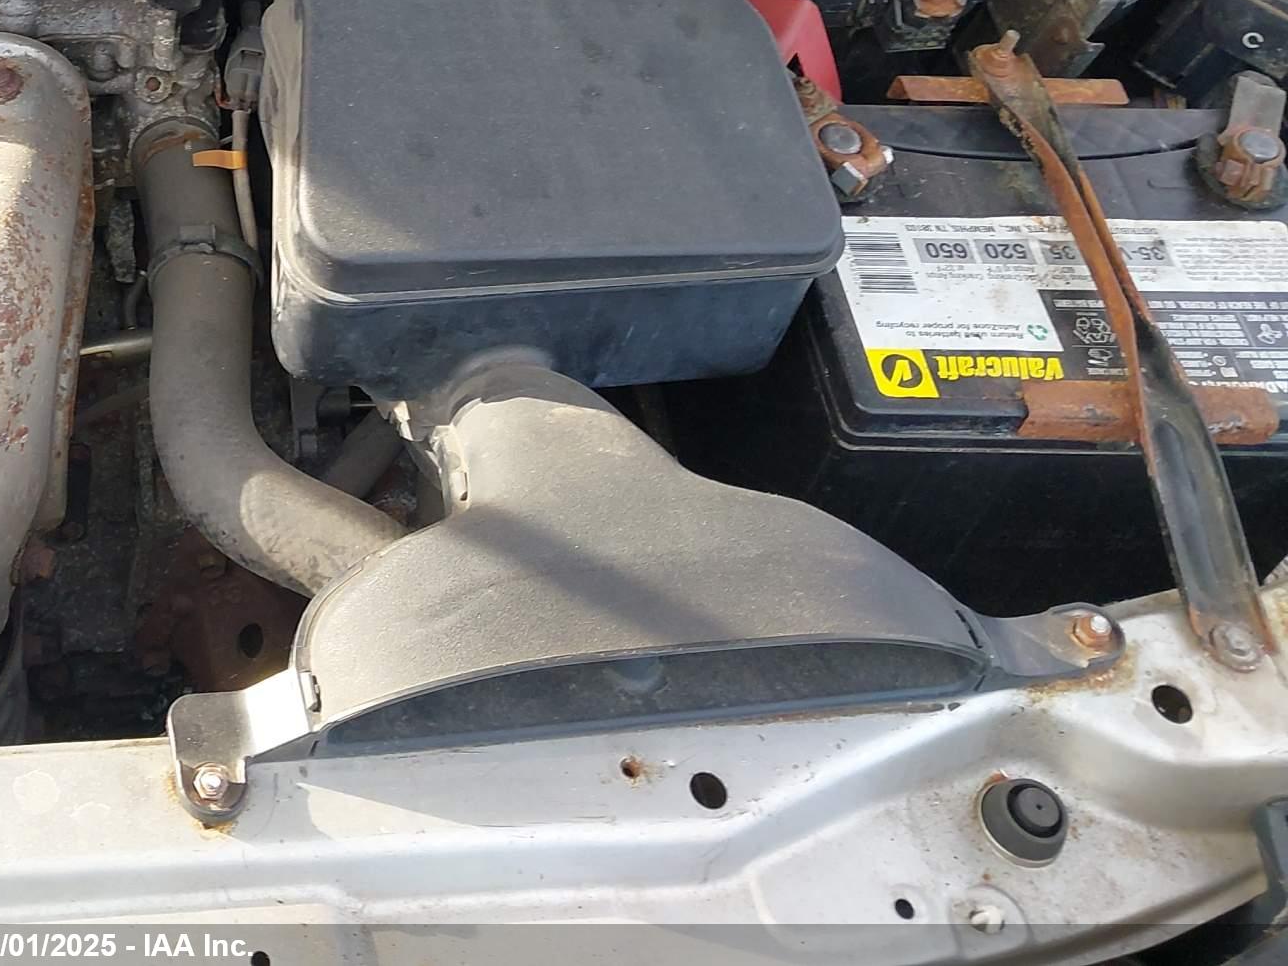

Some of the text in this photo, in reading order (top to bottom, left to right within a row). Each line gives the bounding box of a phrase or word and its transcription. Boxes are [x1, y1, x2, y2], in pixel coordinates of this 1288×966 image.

[926, 242, 967, 259] 650
[985, 242, 1027, 260] 520
[1049, 244, 1076, 260] 35
[875, 320, 1020, 331] AutoZone for proper recycling
[906, 330, 916, 338] to
[919, 331, 961, 340] batteries
[991, 332, 1024, 340] Return
[936, 355, 1065, 381] Valucraft
